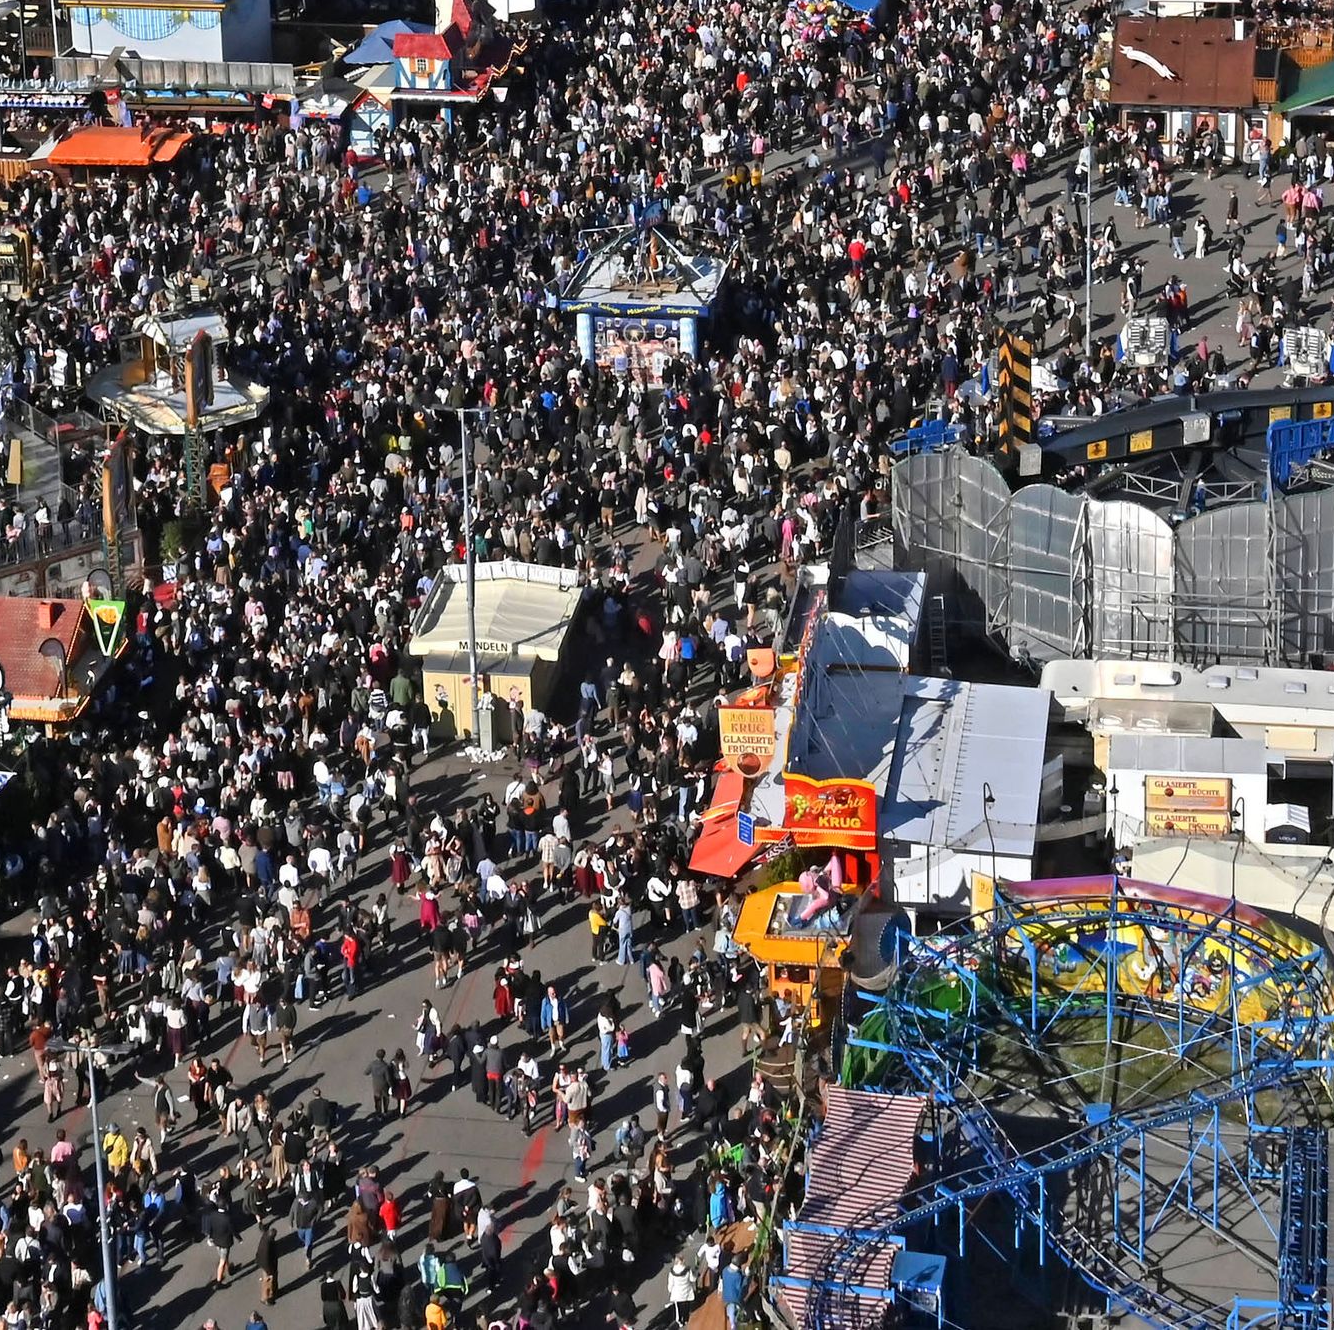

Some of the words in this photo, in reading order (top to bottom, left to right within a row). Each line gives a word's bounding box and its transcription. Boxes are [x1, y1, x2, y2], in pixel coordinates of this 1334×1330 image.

[458, 640, 509, 653] MNDELN
[723, 734, 774, 745] GLASIERTE
[727, 743, 771, 754] FRÜCHTE
[1154, 780, 1198, 789] GLASIERTE
[1188, 788, 1220, 797] FRÜCHTE
[818, 815, 862, 828] KRUG
[1154, 814, 1198, 824] GLASIERTE
